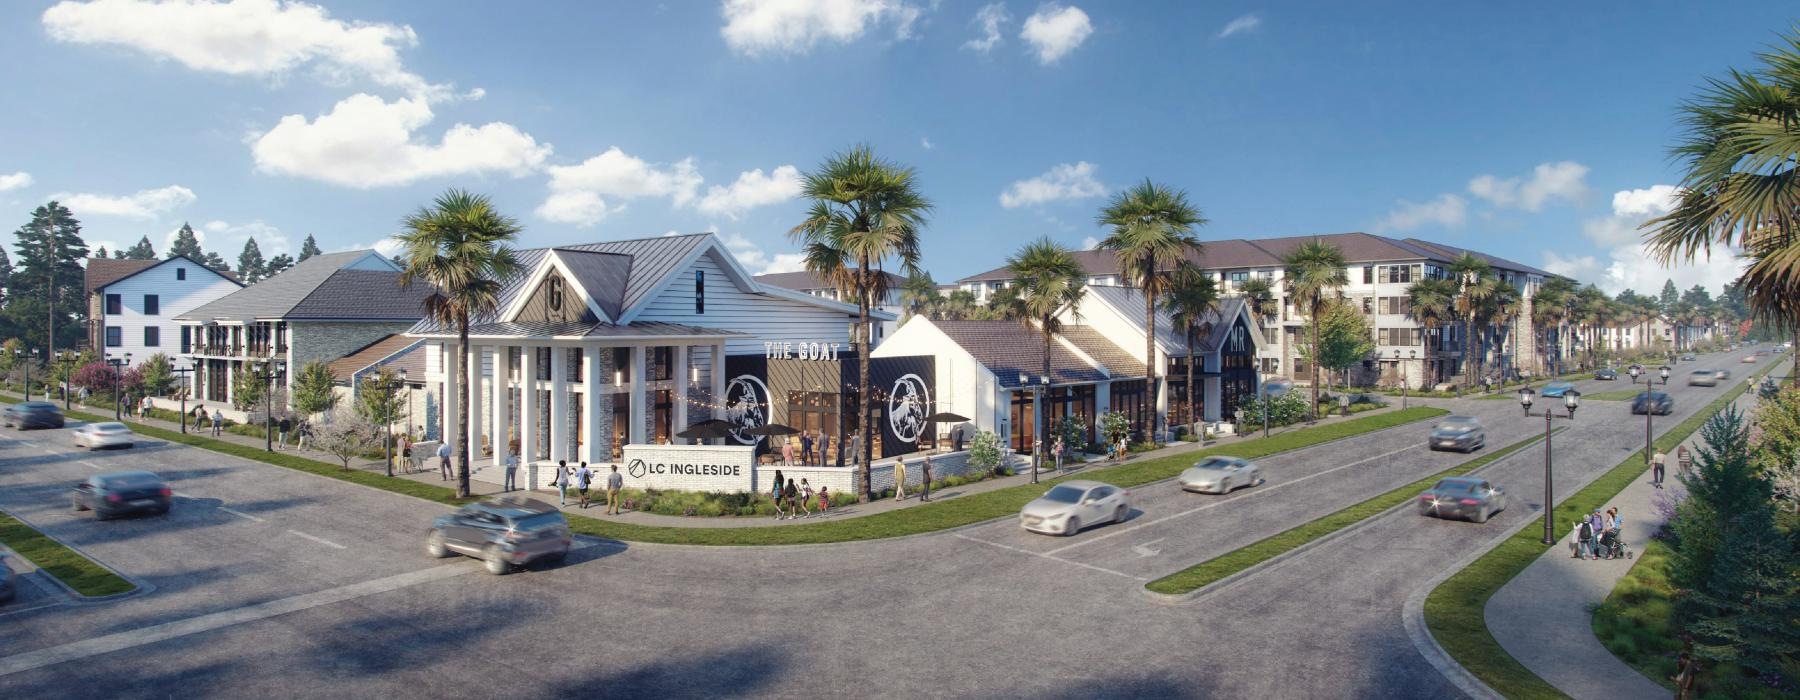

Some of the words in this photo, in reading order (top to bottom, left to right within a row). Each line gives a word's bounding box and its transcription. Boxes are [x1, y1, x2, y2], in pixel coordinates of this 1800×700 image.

[550, 275, 561, 311] G
[1230, 326, 1245, 352] MR
[764, 341, 792, 360] THE
[798, 342, 840, 361] GOAT
[649, 463, 665, 474] LC
[670, 463, 740, 476] INGLESIDE
